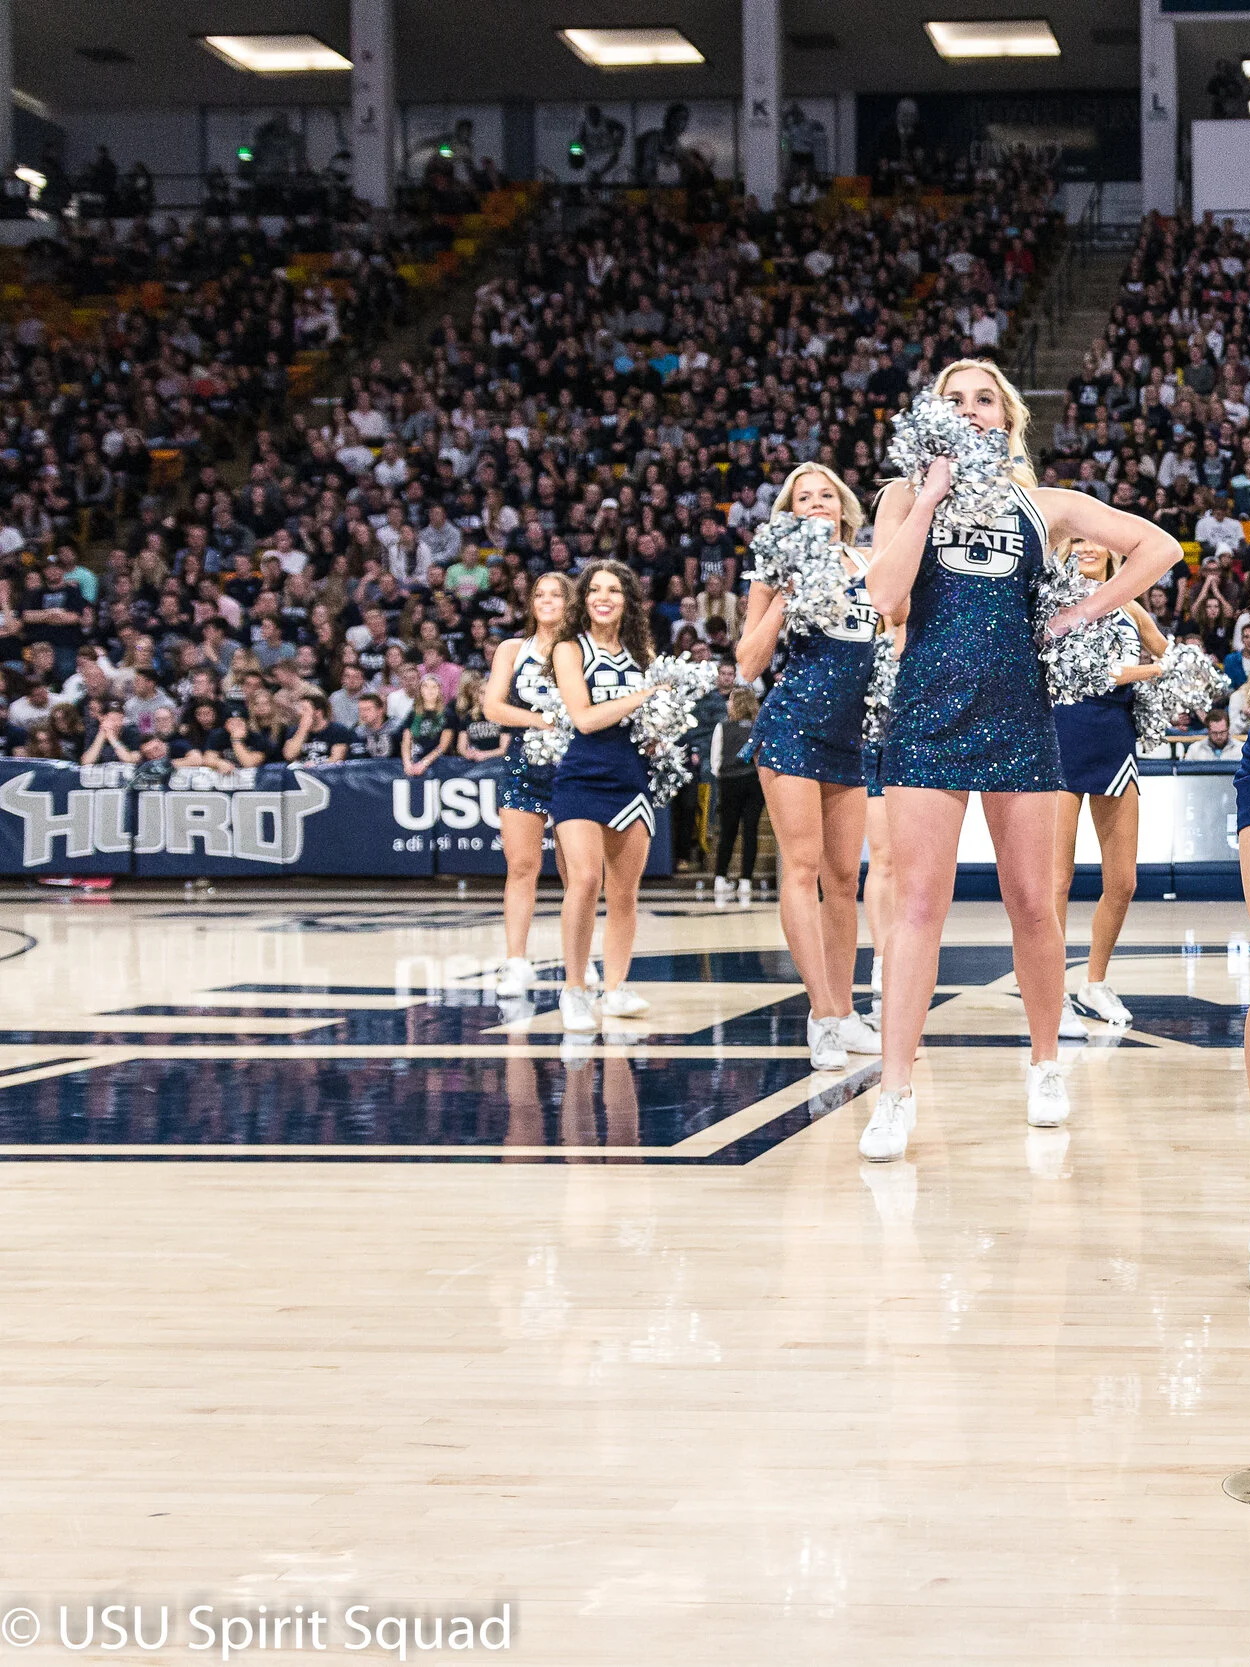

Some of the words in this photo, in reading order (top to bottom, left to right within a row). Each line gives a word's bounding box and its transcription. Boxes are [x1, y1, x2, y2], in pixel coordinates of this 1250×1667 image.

[753, 101, 769, 117] K
[1152, 93, 1167, 111] L
[362, 105, 373, 124] J
[932, 526, 1024, 557] STATE
[0, 770, 331, 867] HURD
